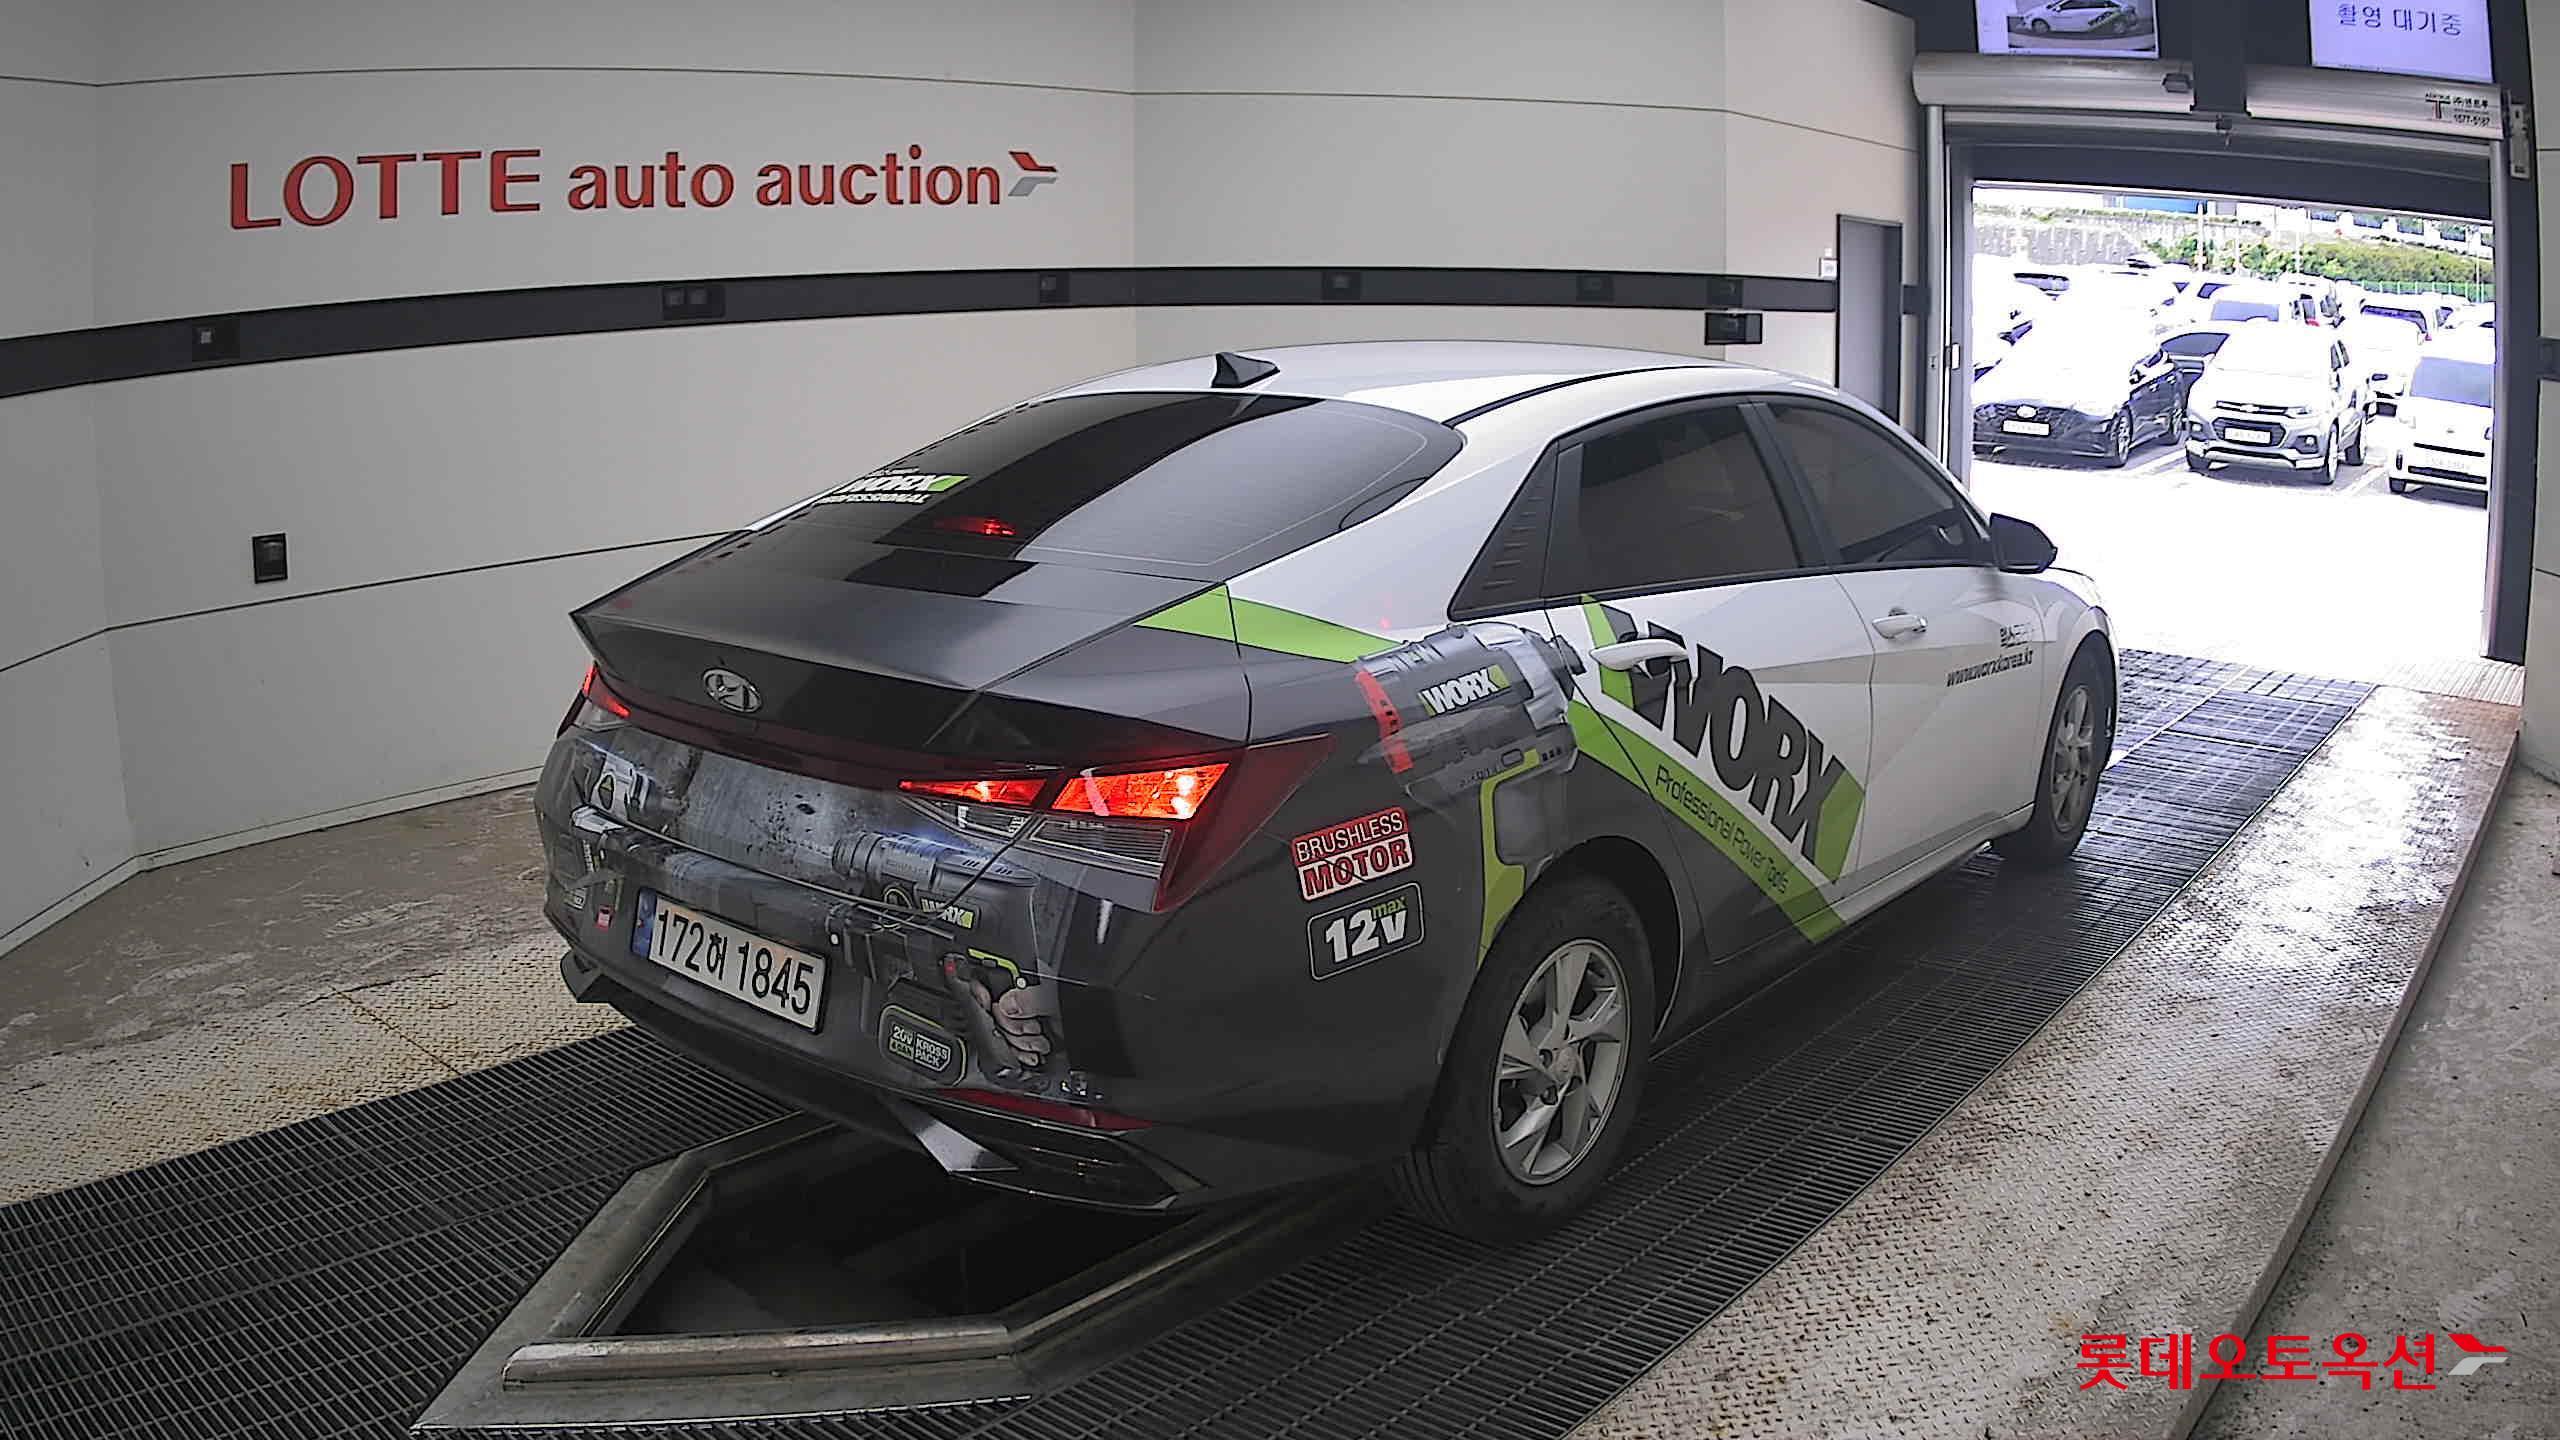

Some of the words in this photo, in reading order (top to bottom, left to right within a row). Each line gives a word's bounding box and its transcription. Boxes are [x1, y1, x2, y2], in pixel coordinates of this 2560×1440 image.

[2338, 4, 2381, 28] 촬영
[2393, 9, 2461, 36] 대기중
[230, 149, 541, 230] LOTTE
[568, 151, 735, 209] auto
[756, 144, 1001, 206] auction
[1421, 668, 1499, 715] WORX
[1601, 603, 1848, 866] WORX
[1295, 811, 1403, 863] BRUSHLESS
[1656, 764, 1735, 842] Professional
[1732, 826, 1766, 869] Power
[1302, 837, 1411, 897] MOTOR
[658, 909, 729, 981] 172허
[738, 941, 814, 1015] 1845
[915, 1048, 941, 1068] PACK
